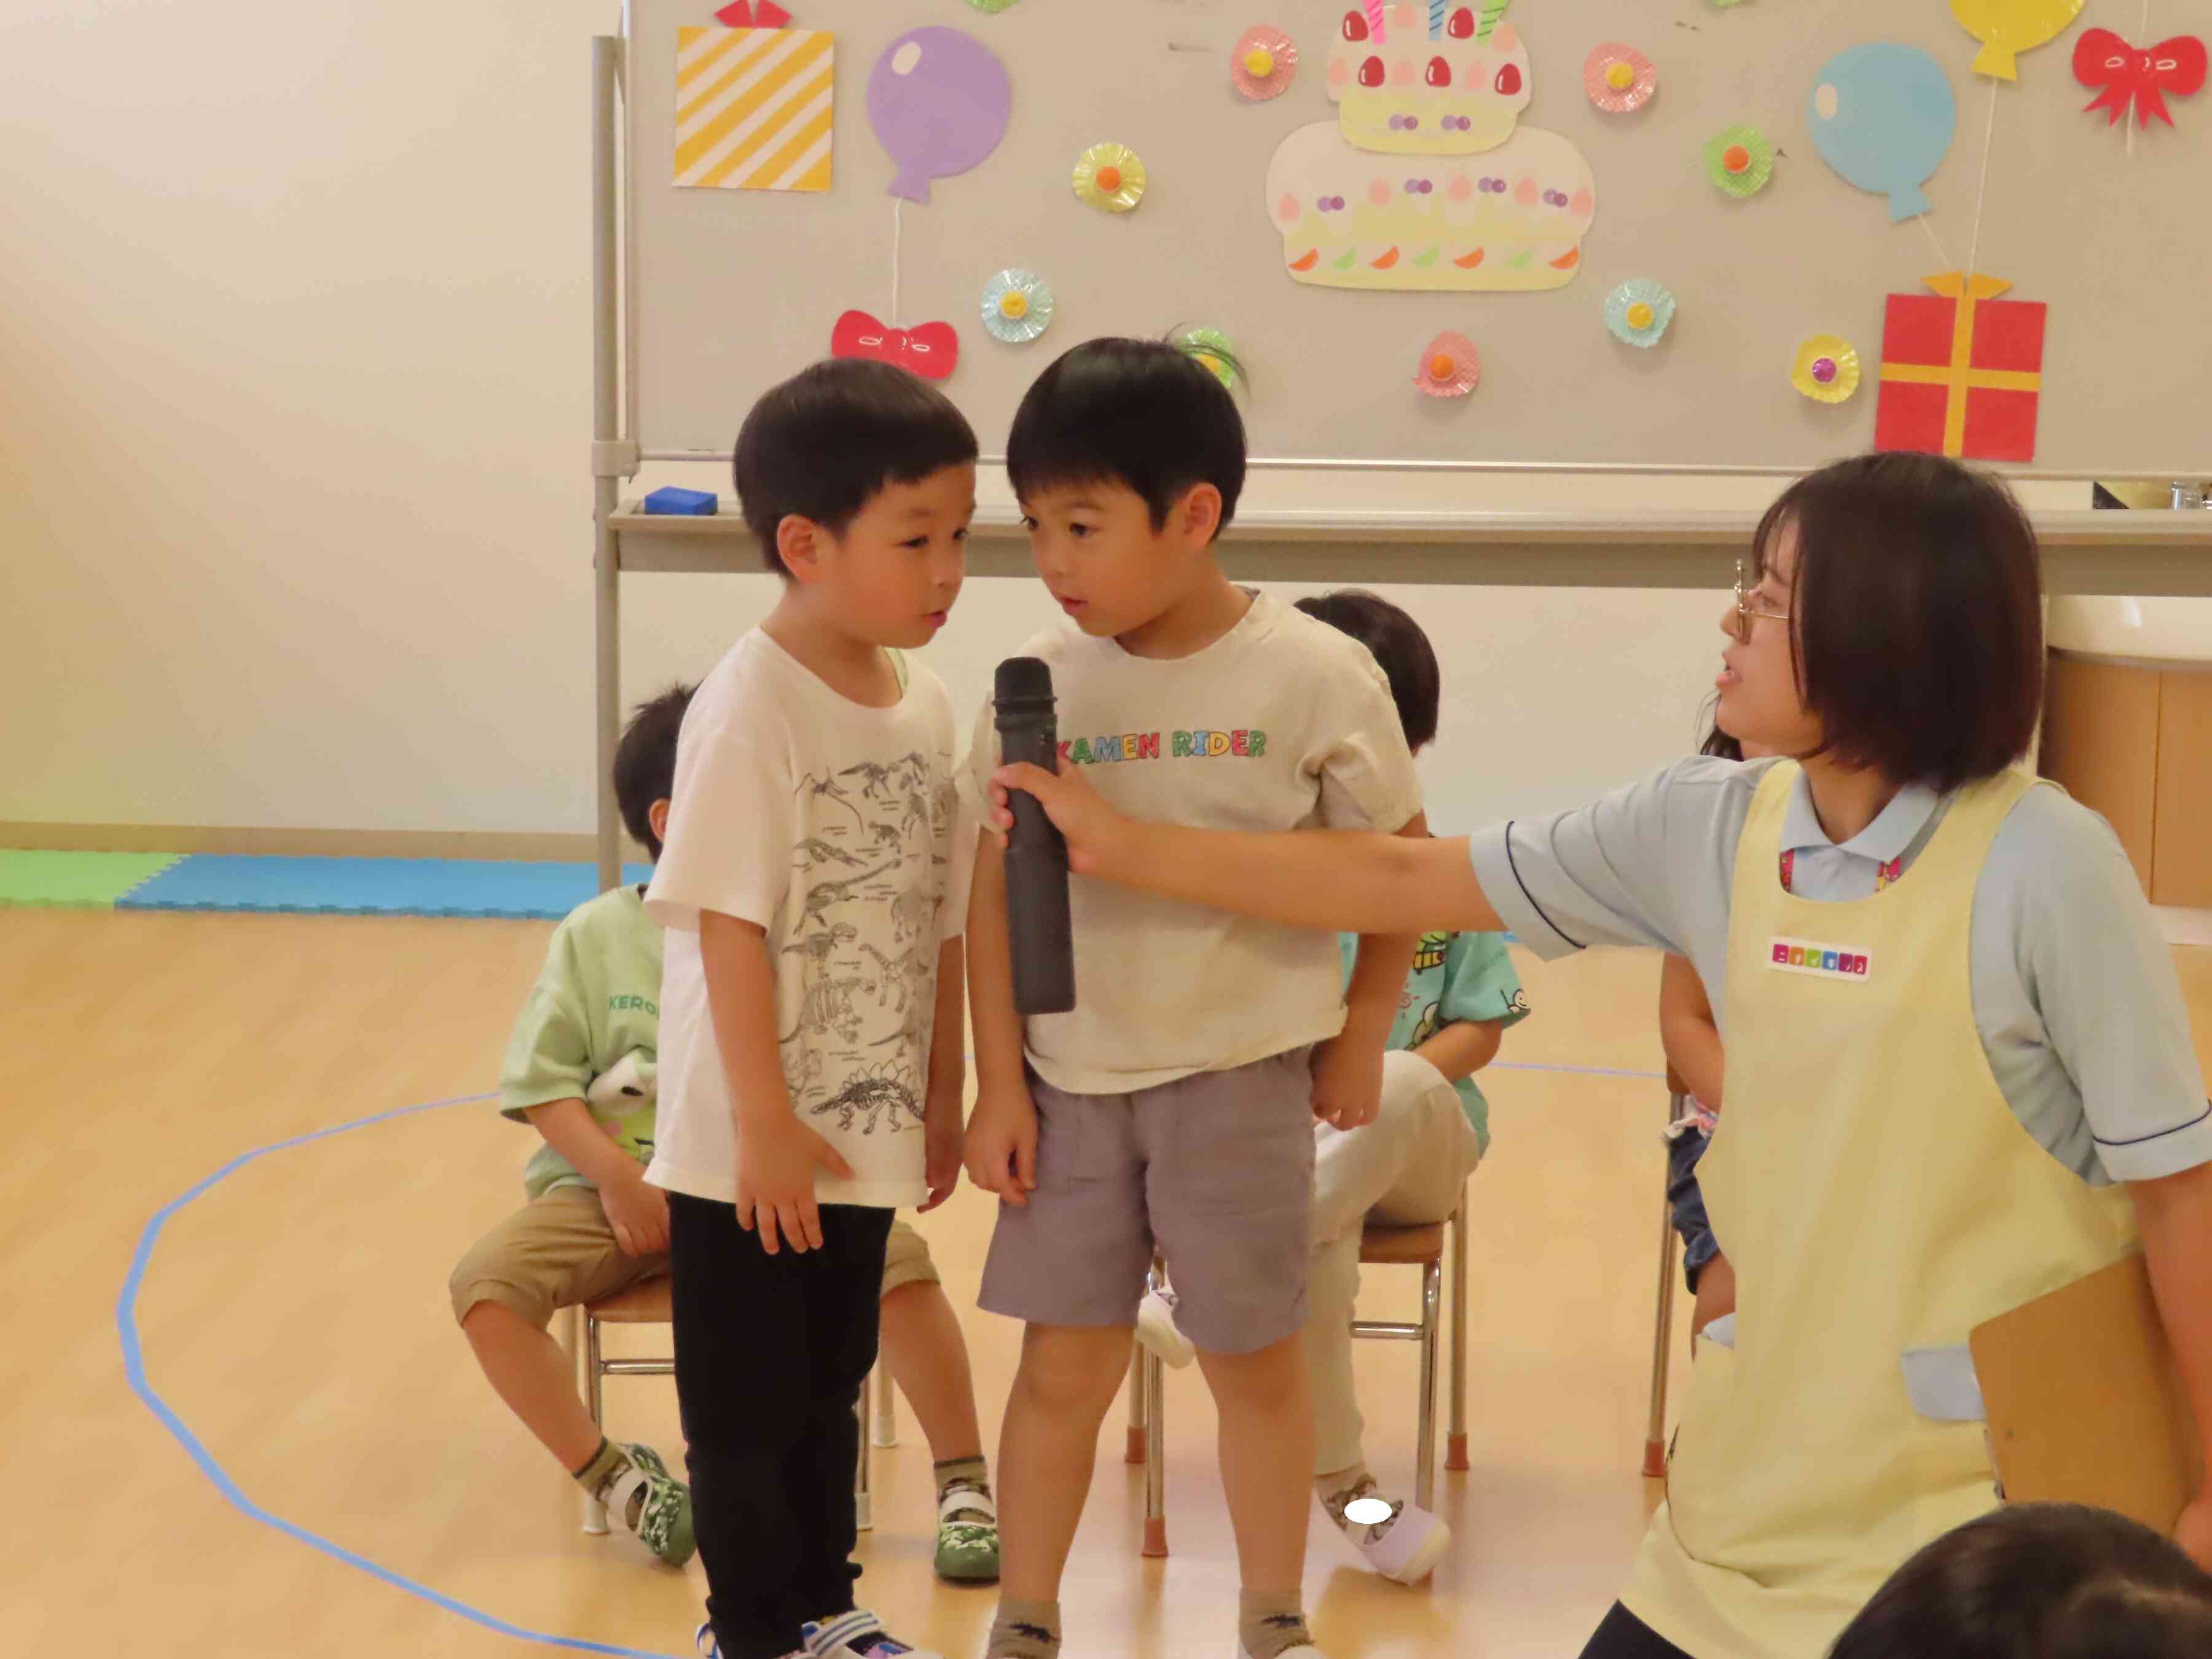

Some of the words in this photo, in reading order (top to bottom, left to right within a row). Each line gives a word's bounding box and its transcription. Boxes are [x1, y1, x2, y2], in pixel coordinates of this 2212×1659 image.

[1056, 732, 1160, 764] KAMEN
[1172, 730, 1267, 758] RIDER
[609, 994, 659, 1020] KERO
